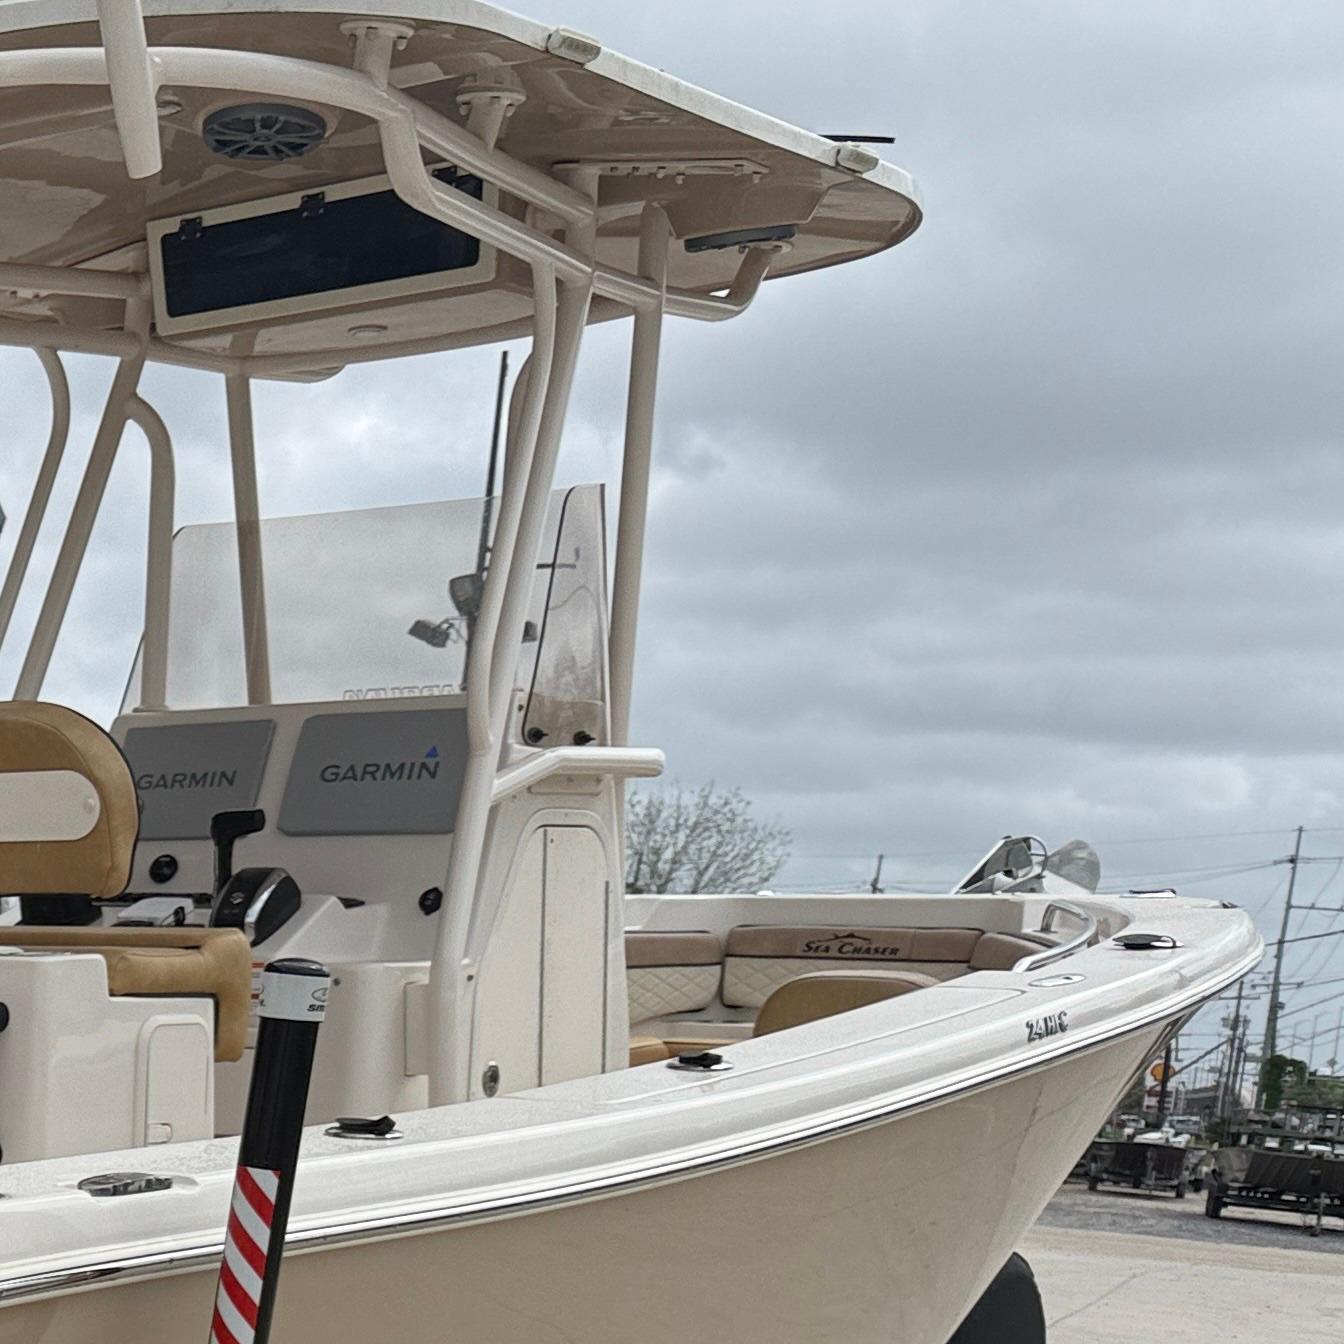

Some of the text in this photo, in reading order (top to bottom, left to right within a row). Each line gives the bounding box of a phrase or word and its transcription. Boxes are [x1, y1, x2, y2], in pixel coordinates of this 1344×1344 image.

[137, 769, 237, 791] GARMIN
[320, 761, 440, 783] GARMIN
[801, 940, 900, 955] SEA CHASER
